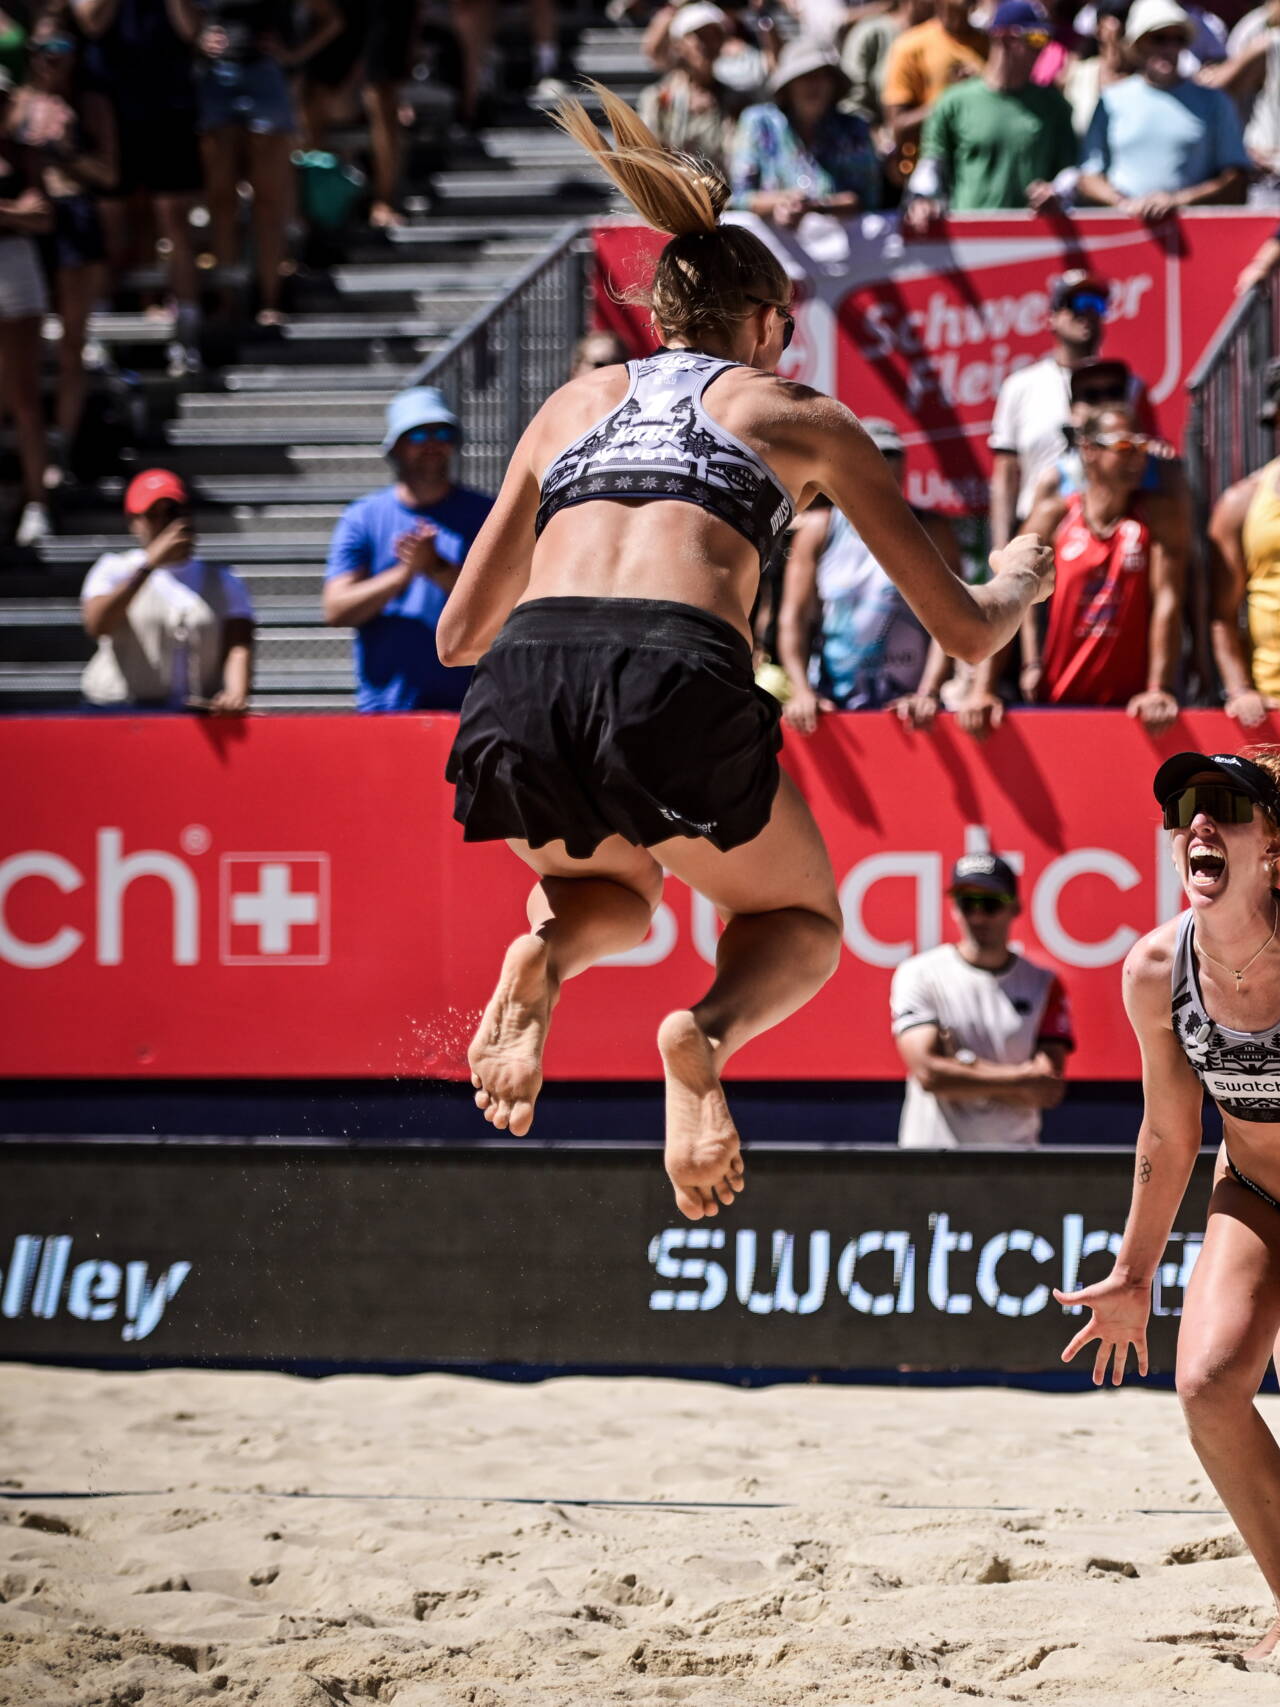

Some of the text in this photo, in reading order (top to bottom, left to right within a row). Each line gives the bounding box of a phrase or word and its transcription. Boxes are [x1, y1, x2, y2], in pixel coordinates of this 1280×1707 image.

[865, 273, 1153, 358] Schweer
[643, 391, 677, 418] 1
[905, 344, 1052, 410] Flei
[610, 424, 686, 442] KRAFT
[624, 448, 691, 462] VBTV
[0, 1234, 193, 1342] lley
[648, 1212, 1124, 1317] swatch
